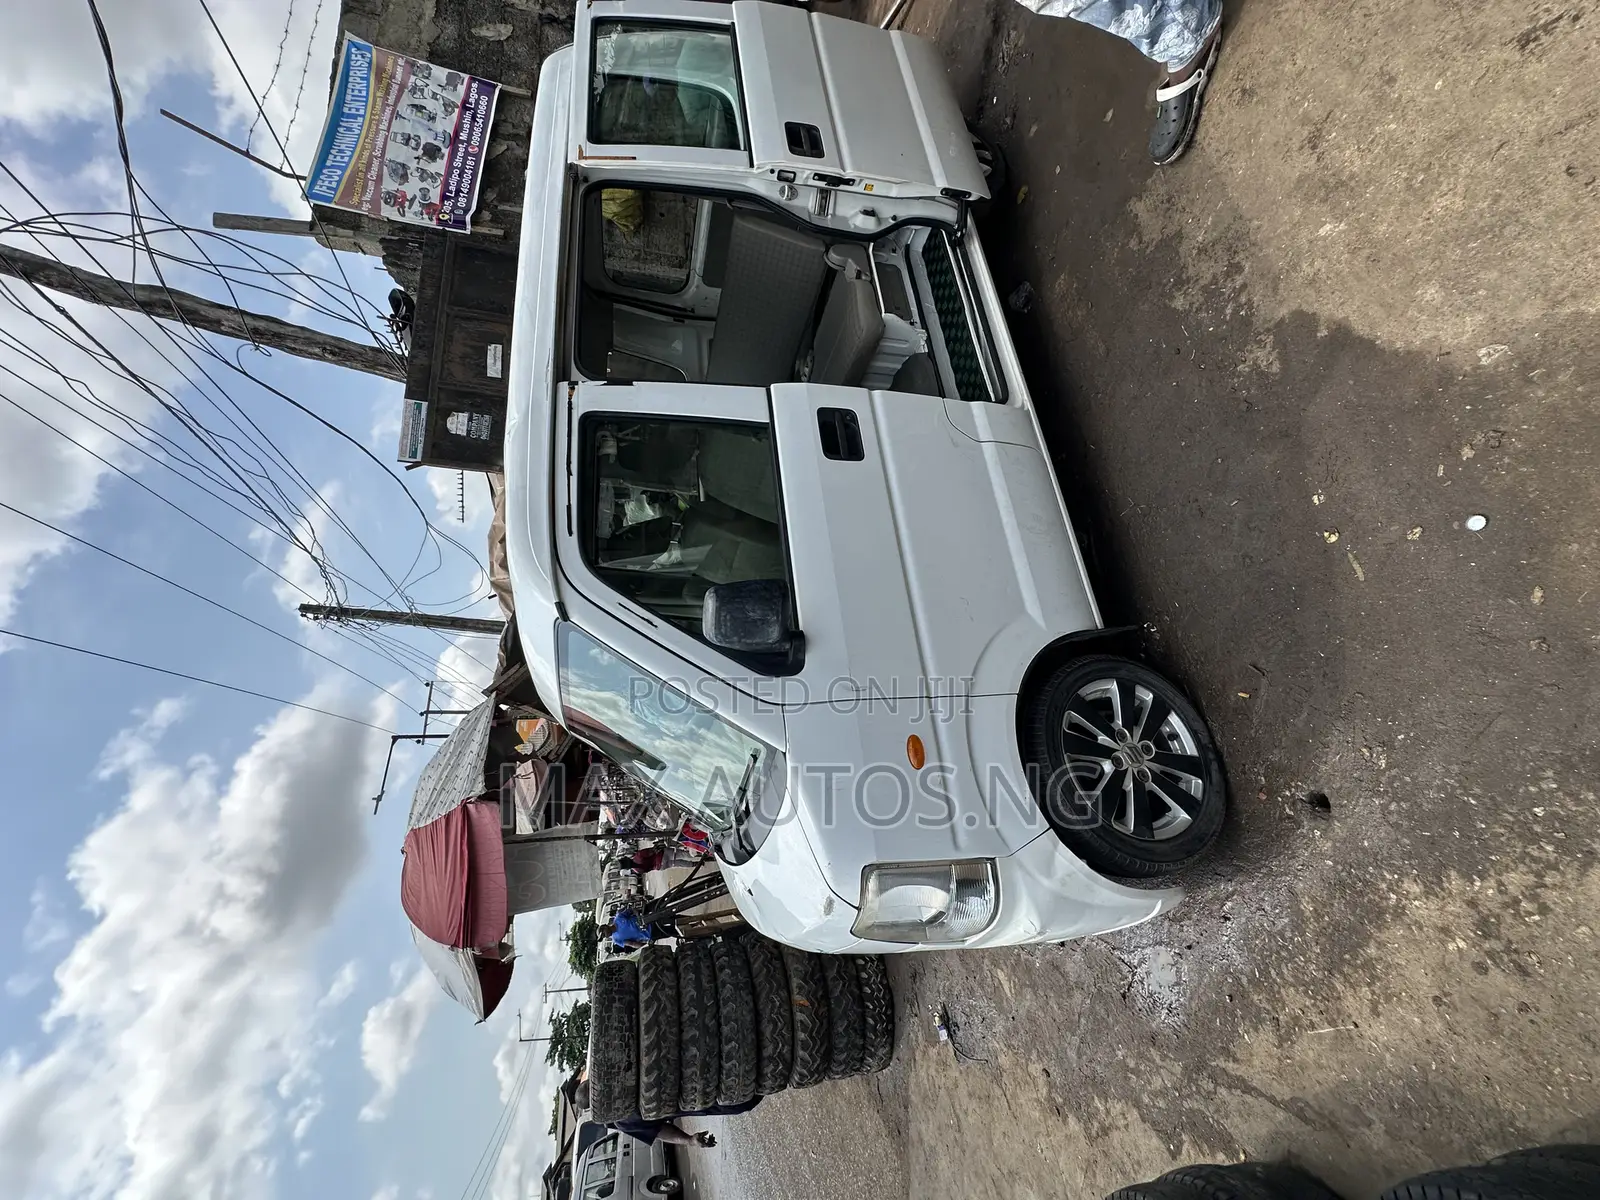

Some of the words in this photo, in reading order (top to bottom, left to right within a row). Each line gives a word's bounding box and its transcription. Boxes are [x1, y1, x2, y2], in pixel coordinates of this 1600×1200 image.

[344, 48, 372, 115] ENTERPRISES
[467, 81, 479, 108] Lagos.
[460, 110, 474, 141] Mushin,
[326, 118, 364, 165] TECHNICAL
[454, 142, 468, 168] Street,
[313, 168, 342, 198] IFECO
[447, 169, 460, 197] Ladipo
